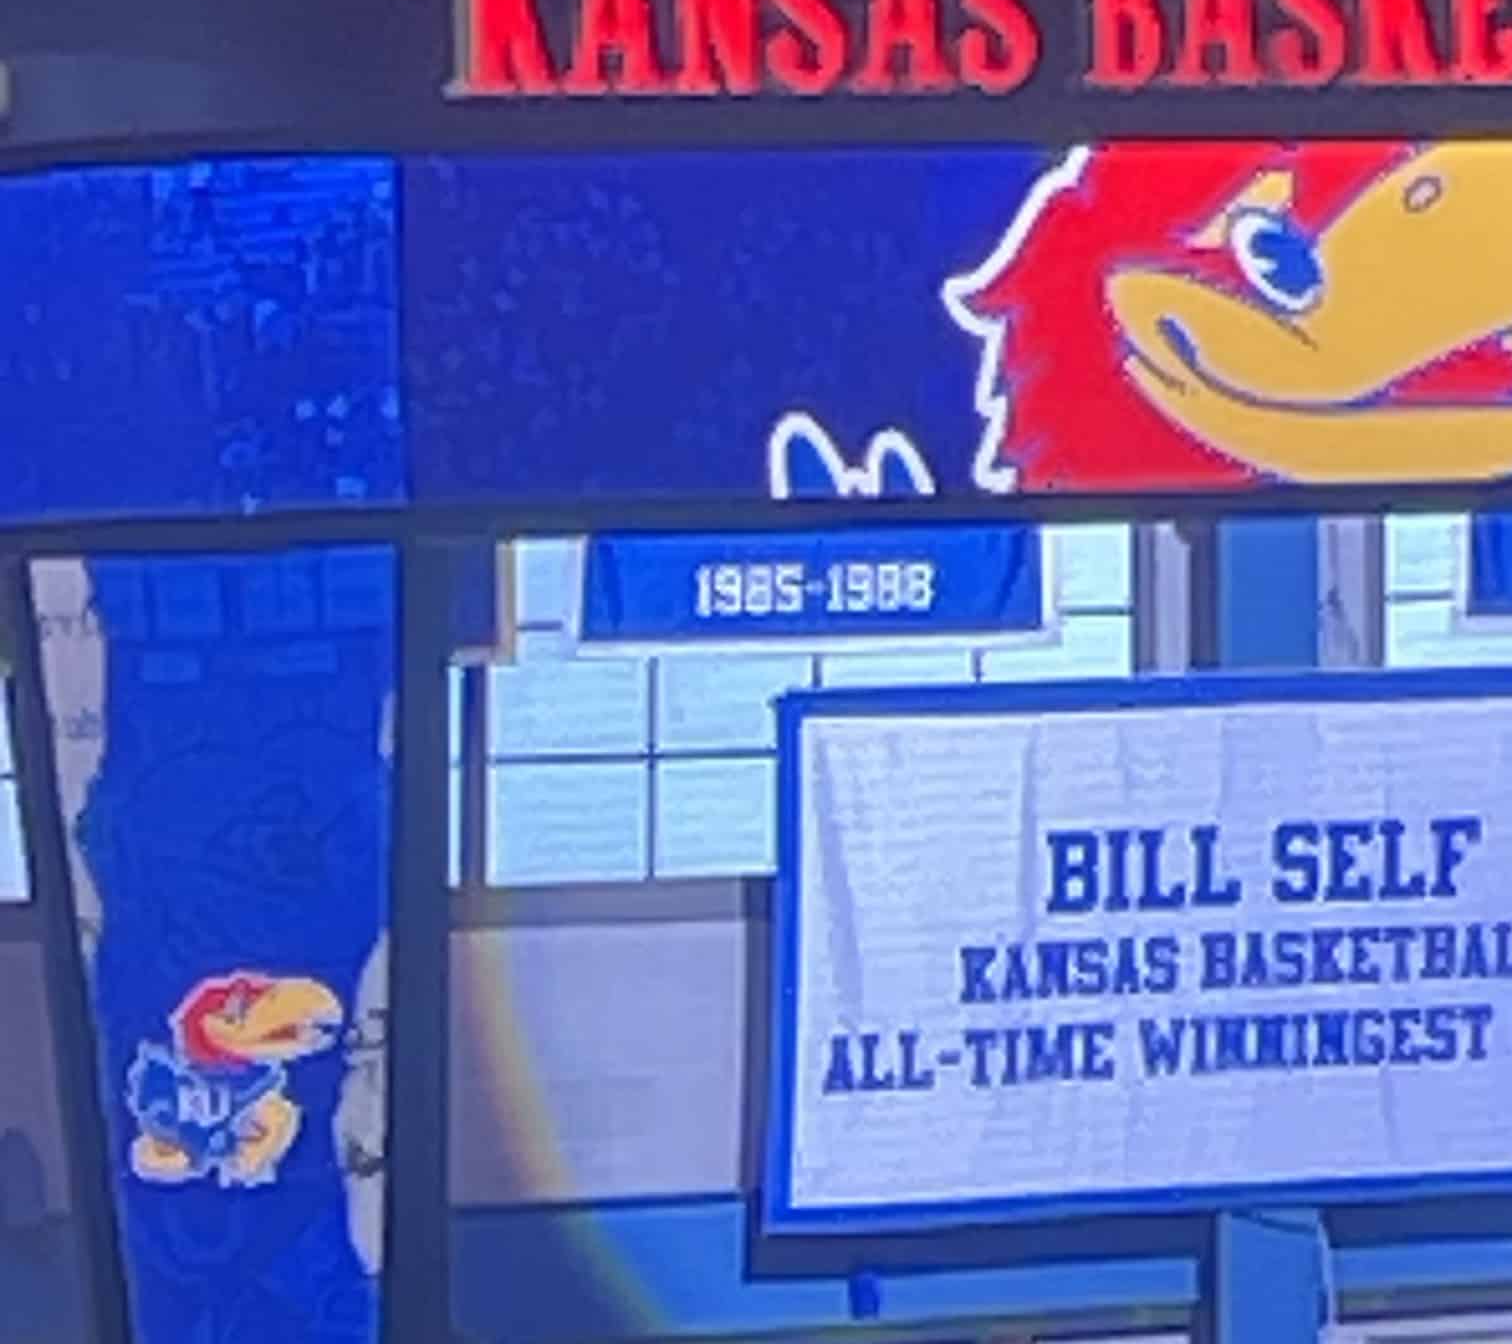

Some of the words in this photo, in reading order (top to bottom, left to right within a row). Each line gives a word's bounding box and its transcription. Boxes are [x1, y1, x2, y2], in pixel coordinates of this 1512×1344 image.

[1046, 824, 1242, 913] BILL
[1272, 817, 1481, 902] SELF
[960, 936, 1180, 1003] KANSAS
[822, 1022, 1115, 1095] ALL-TIME
[1139, 1003, 1492, 1078] WINNINGEST
